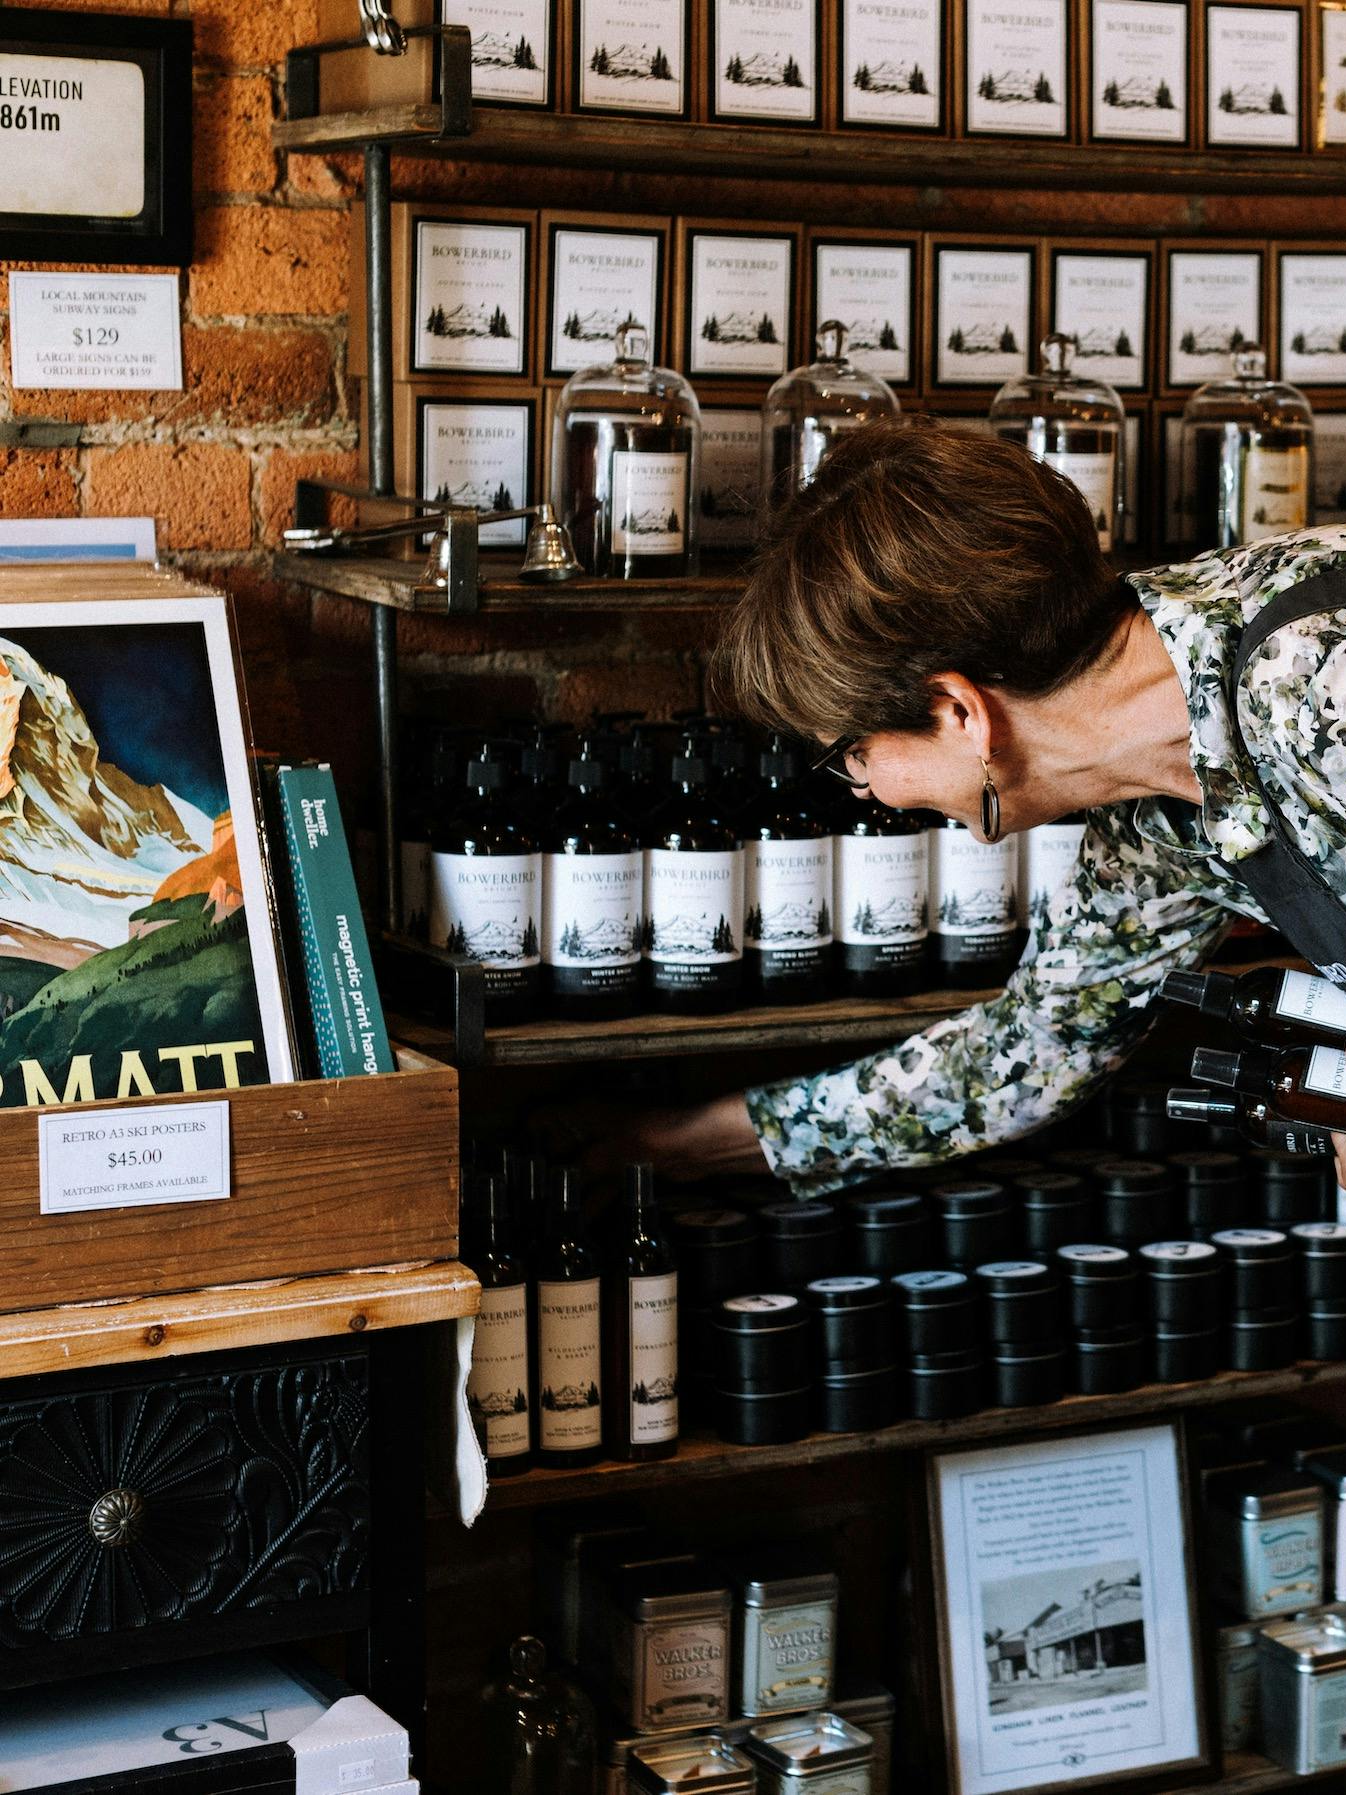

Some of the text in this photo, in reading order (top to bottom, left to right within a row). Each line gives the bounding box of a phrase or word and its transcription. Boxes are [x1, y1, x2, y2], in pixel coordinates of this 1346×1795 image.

[432, 245, 513, 261] BOWERBIRD
[568, 253, 645, 269] BOWERBIRD
[41, 290, 147, 302] LOCAL MOUNTAIN
[52, 304, 137, 315] SUBWAY SIGNS
[72, 327, 119, 346] $129
[114, 354, 139, 364] CAN
[103, 366, 126, 376] FOR
[438, 426, 516, 439] BOWERBIRD
[313, 799, 329, 837] home
[457, 871, 535, 884] BOWERBIRD
[651, 867, 730, 881] BOWERBIRD
[332, 952, 340, 967] THE
[336, 914, 363, 989] magnetic
[335, 967, 344, 985] EASY
[349, 990, 371, 1030] print
[345, 1018, 358, 1054] SOLUTION
[0, 1040, 254, 1107] MATT
[62, 1121, 207, 1144] RETRO A3 SKI POSTERS
[108, 1149, 162, 1169] $45.00
[62, 1175, 208, 1198] MATCHING FRAMES AVAILABLE
[767, 1628, 831, 1650] WALKER
[654, 1645, 721, 1666] WALKER
